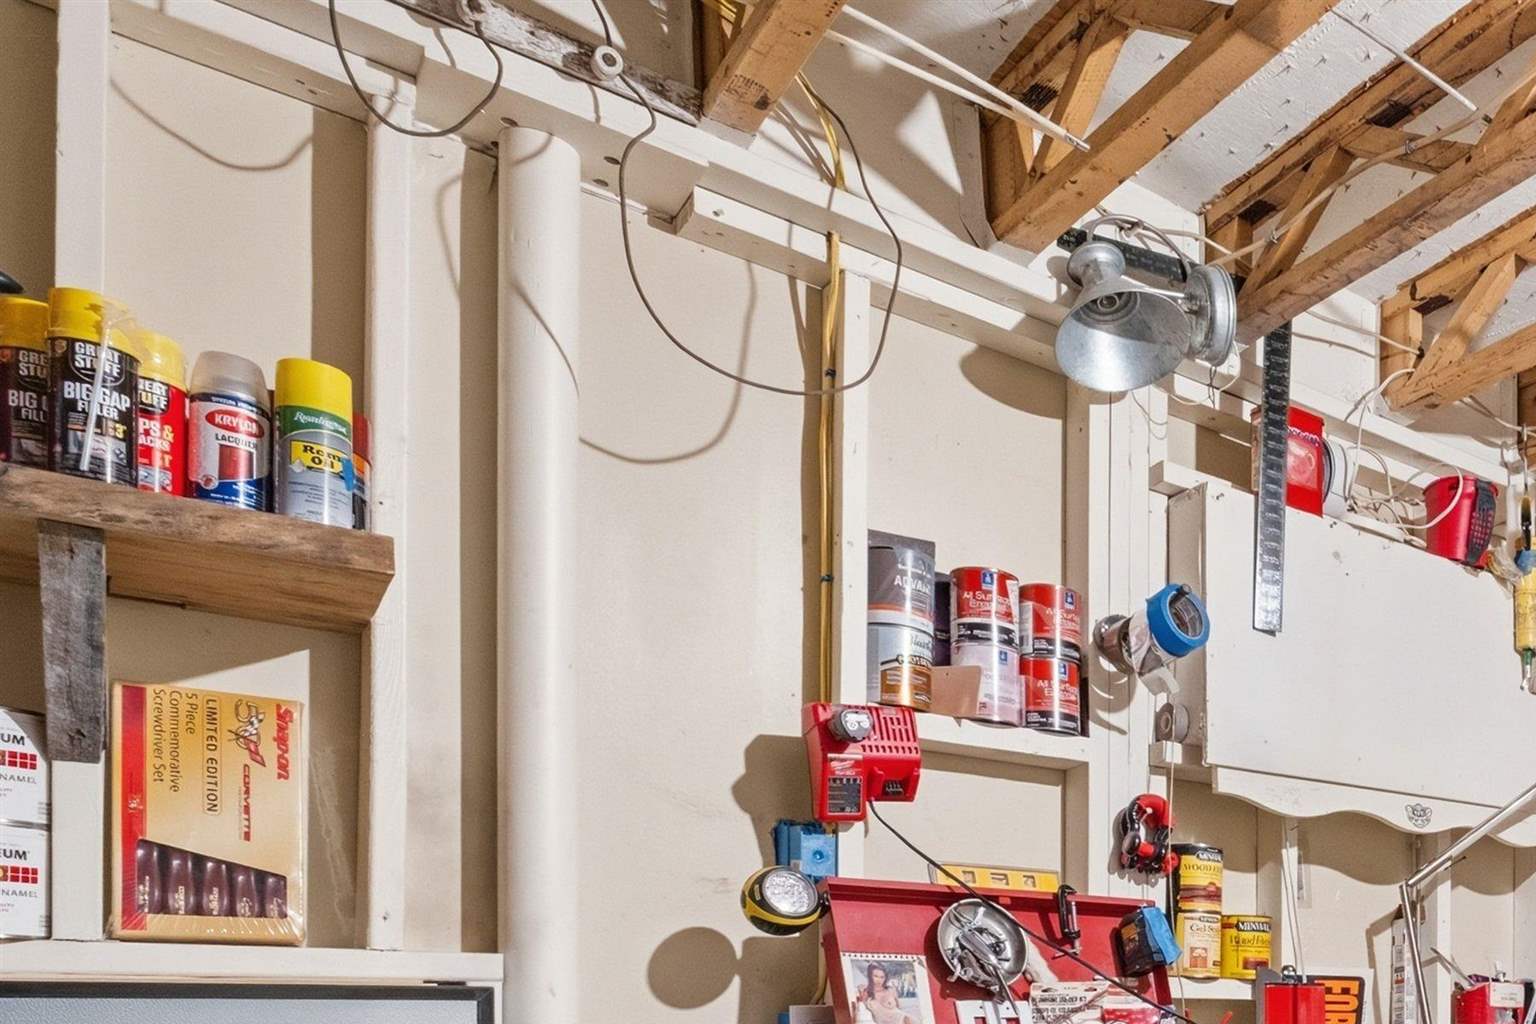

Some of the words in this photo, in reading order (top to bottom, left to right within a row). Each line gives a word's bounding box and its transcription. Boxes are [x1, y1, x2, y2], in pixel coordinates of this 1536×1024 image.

[8, 389, 36, 408] BIG
[77, 400, 119, 421] FILER
[214, 413, 258, 434] KRYLON
[302, 444, 342, 463] Rem
[186, 692, 198, 700] 5
[153, 688, 167, 760] Screwdriver
[185, 702, 199, 735] Piece
[206, 698, 218, 752] LIMITED
[169, 690, 183, 792] Commemorative
[272, 704, 294, 780] Snap-on
[154, 763, 167, 783] Set
[206, 757, 219, 813] EDITION
[243, 763, 252, 842] CORVETTE
